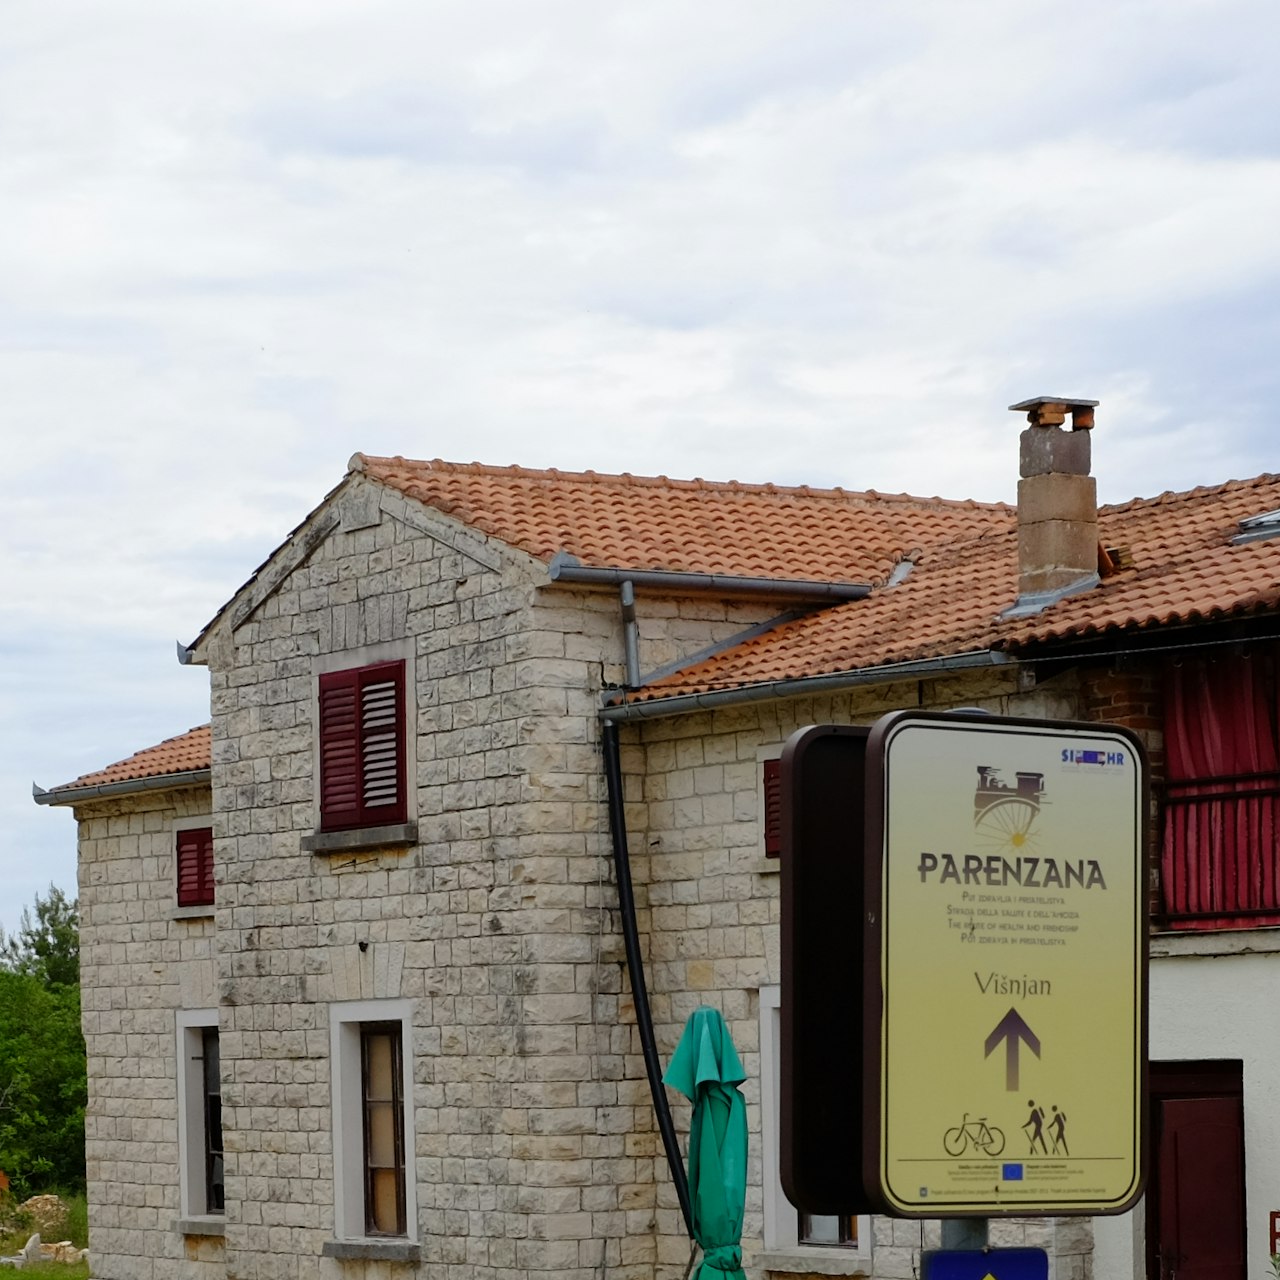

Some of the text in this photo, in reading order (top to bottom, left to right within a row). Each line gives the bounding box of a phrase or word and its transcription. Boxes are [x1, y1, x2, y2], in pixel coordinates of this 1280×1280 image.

[1061, 748, 1124, 766] SI HR
[917, 852, 1108, 890] PARENZANA
[973, 971, 1052, 1000] Višnjan
